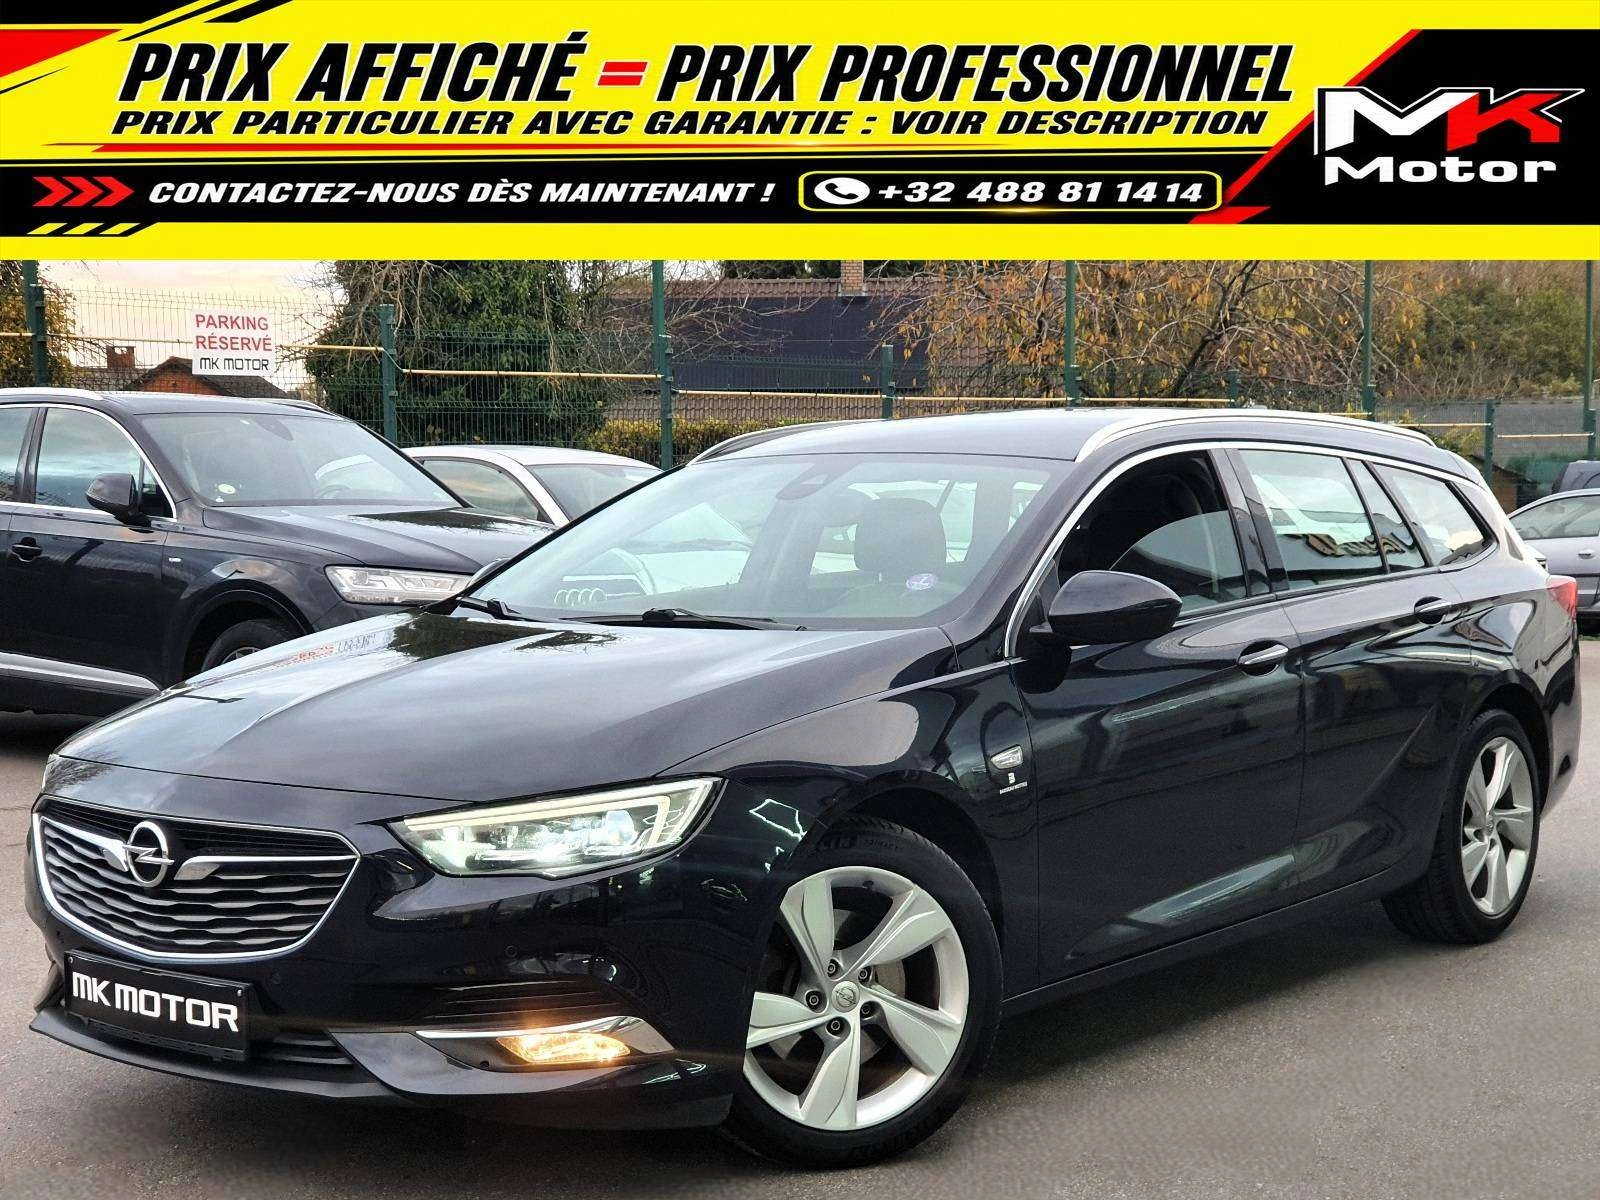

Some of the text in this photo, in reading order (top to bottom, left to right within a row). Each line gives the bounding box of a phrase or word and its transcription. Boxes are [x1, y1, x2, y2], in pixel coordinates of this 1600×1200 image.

[195, 314, 269, 331] PARKING
[195, 333, 272, 351] RÉSERVÉ
[199, 357, 270, 371] MK MOTOR
[72, 971, 239, 1033] MK MOTOR
